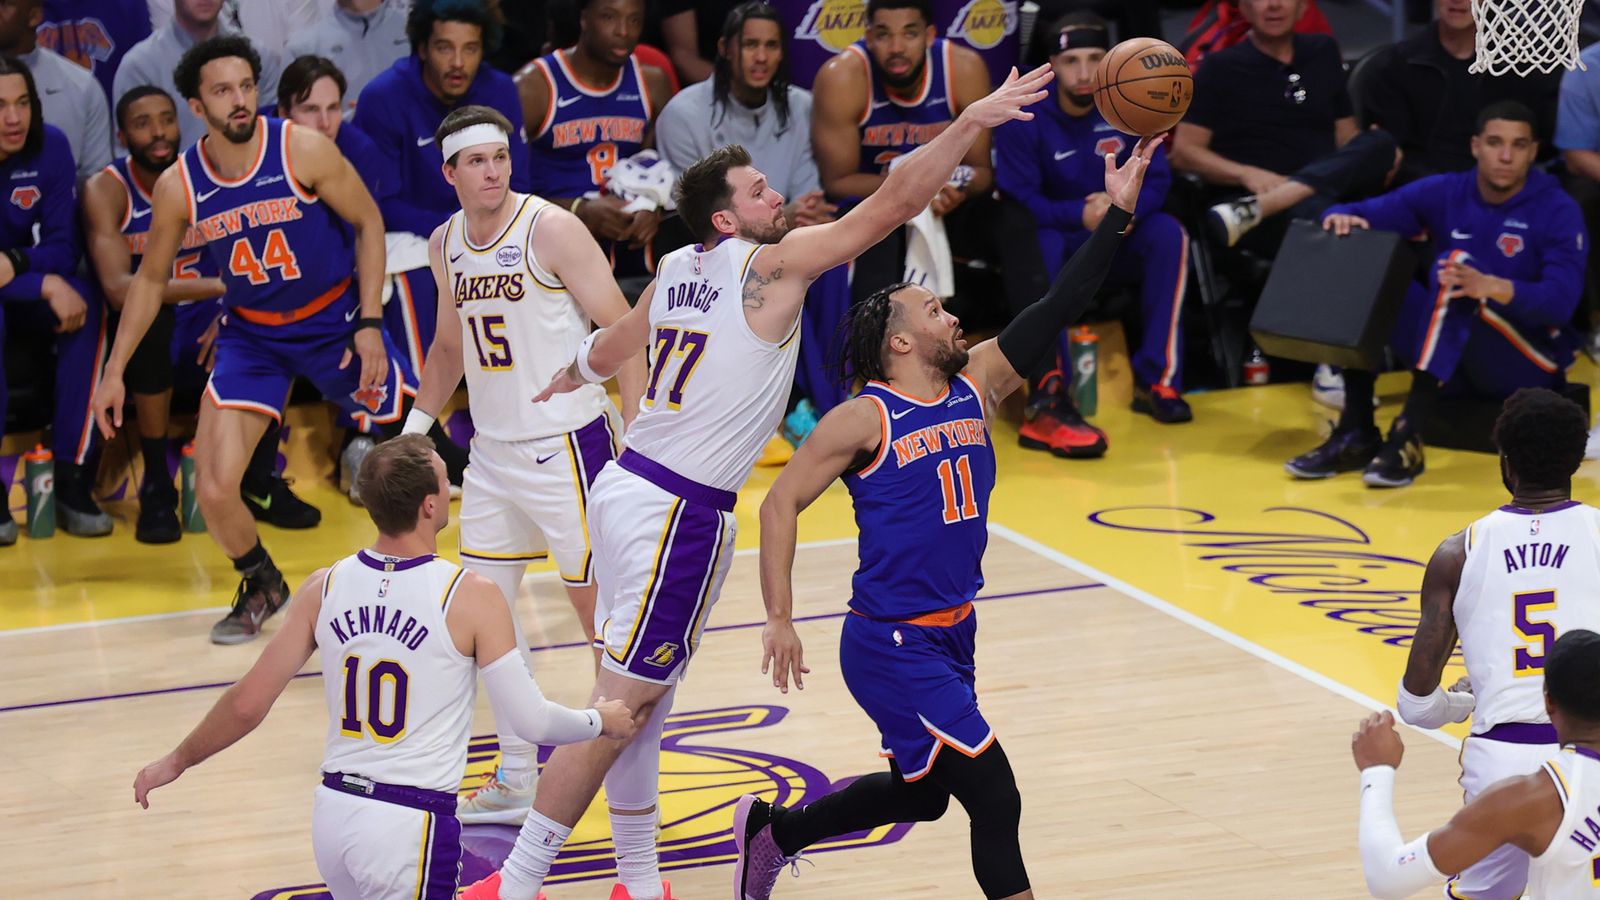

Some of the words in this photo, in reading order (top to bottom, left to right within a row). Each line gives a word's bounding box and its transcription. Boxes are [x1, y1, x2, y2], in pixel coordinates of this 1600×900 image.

[552, 118, 598, 149] NEW
[586, 141, 619, 186] 8
[197, 209, 243, 243] NEW
[241, 196, 303, 228] YORK
[229, 228, 302, 286] 44
[498, 250, 521, 261] bibigo
[454, 271, 525, 308] LAKERS
[668, 278, 723, 313] DONČIĆ
[467, 314, 515, 372] 15
[645, 325, 711, 412] 77
[891, 424, 943, 469] NEW
[940, 418, 987, 449] YORK
[936, 454, 980, 525] 11
[1503, 543, 1570, 574] AYTON
[329, 605, 429, 651] KENNARD
[1512, 588, 1558, 678] 5
[340, 653, 410, 744] 10
